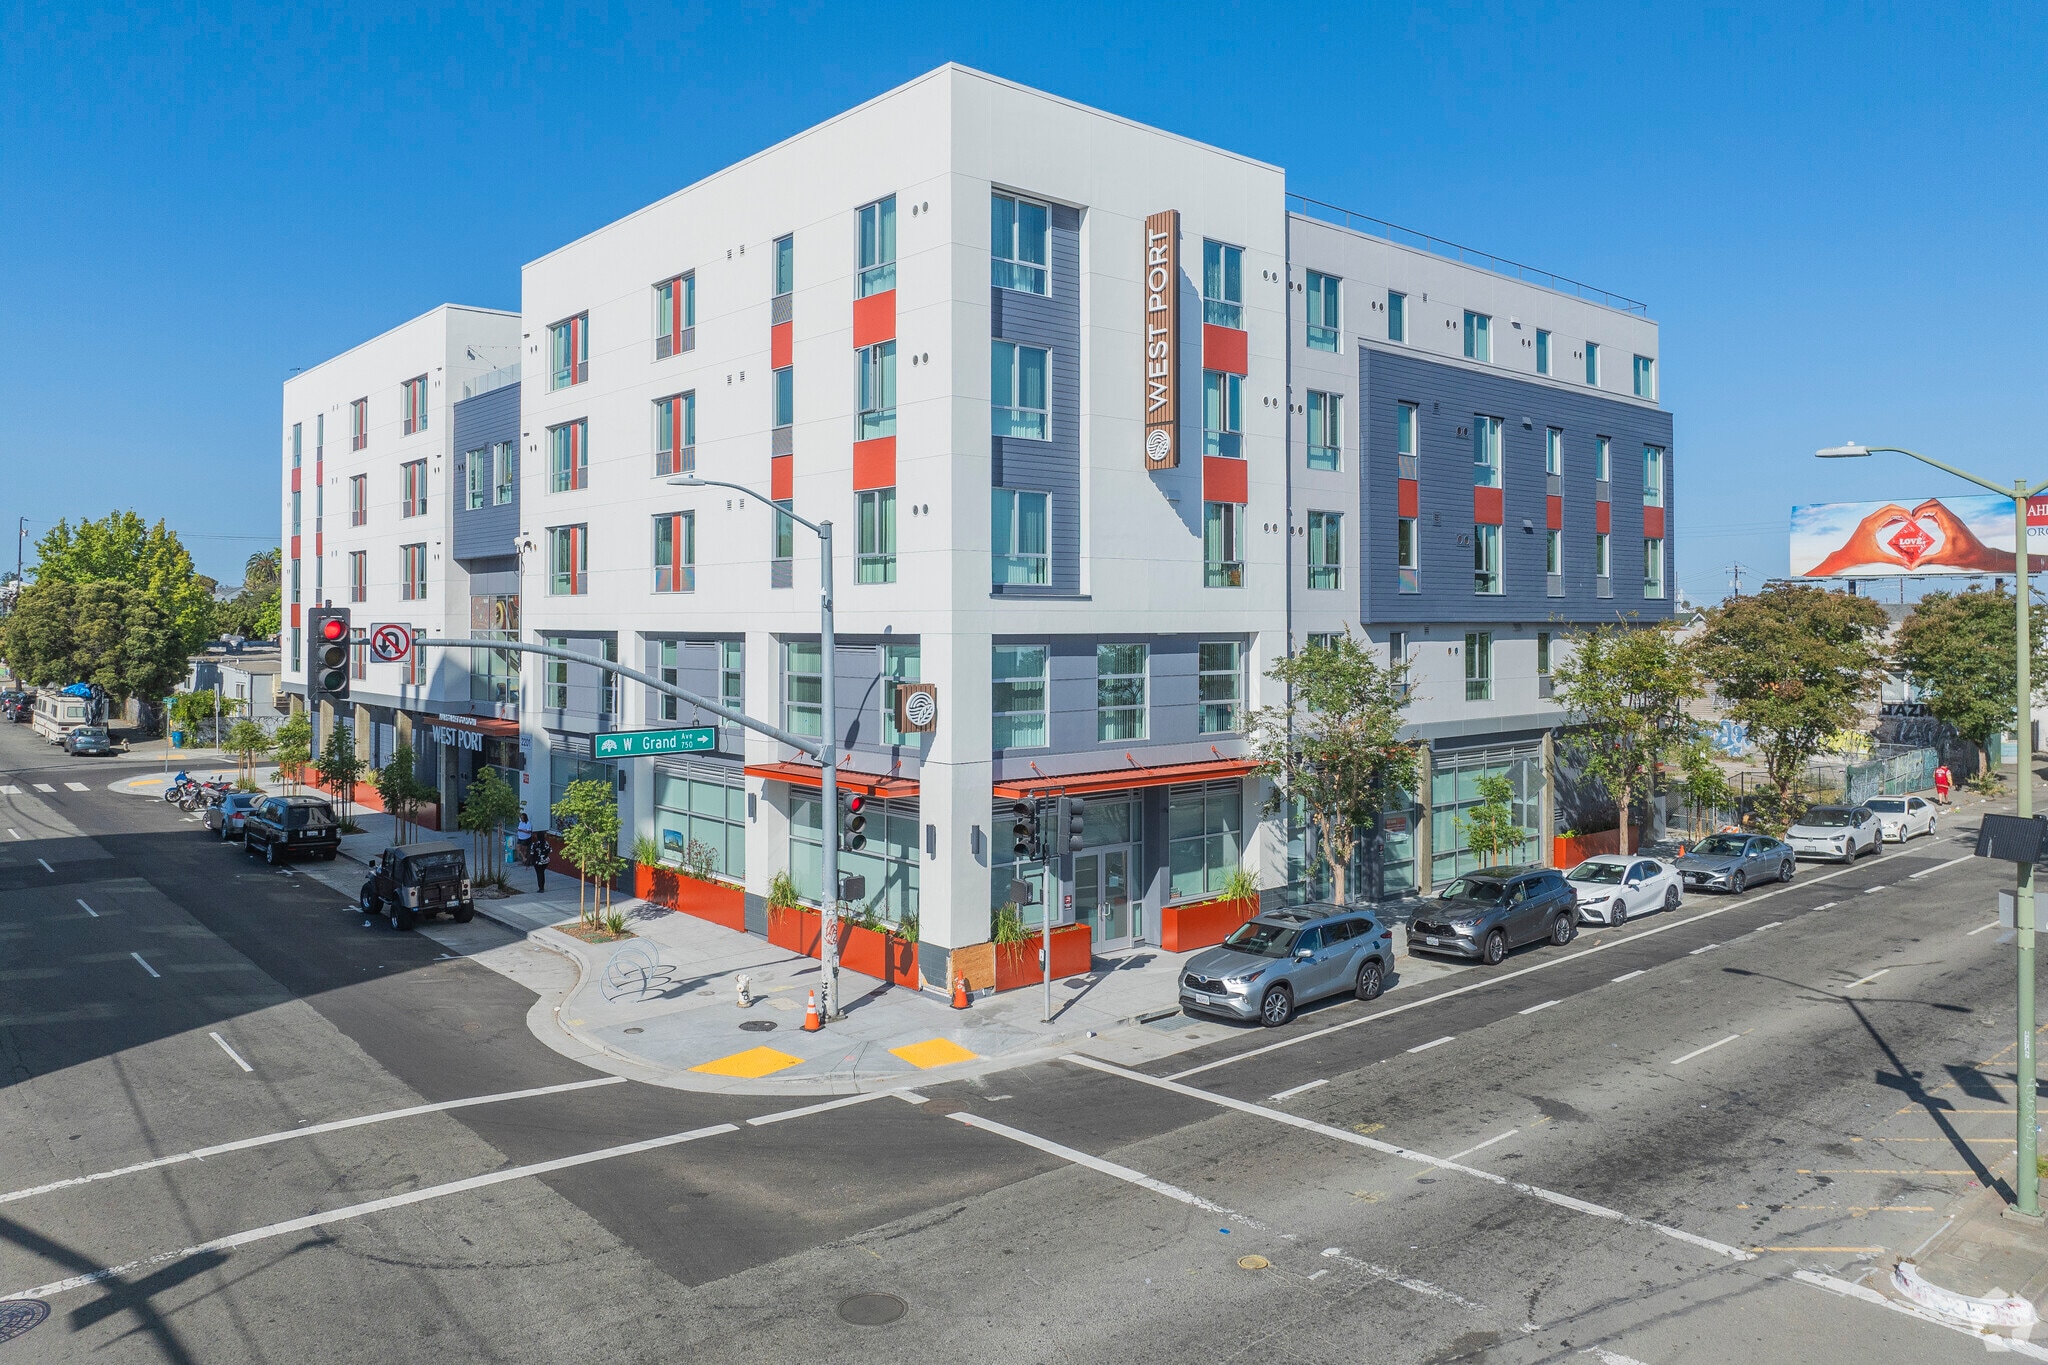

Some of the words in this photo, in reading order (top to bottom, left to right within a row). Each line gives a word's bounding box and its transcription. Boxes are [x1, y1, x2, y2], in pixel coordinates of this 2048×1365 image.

[1149, 228, 1168, 312] PORT
[1149, 323, 1168, 413] WEST
[432, 725, 457, 747] WEST
[458, 729, 483, 752] PORT
[623, 738, 632, 751] W
[642, 736, 677, 750] Grand
[681, 741, 693, 749] 750
